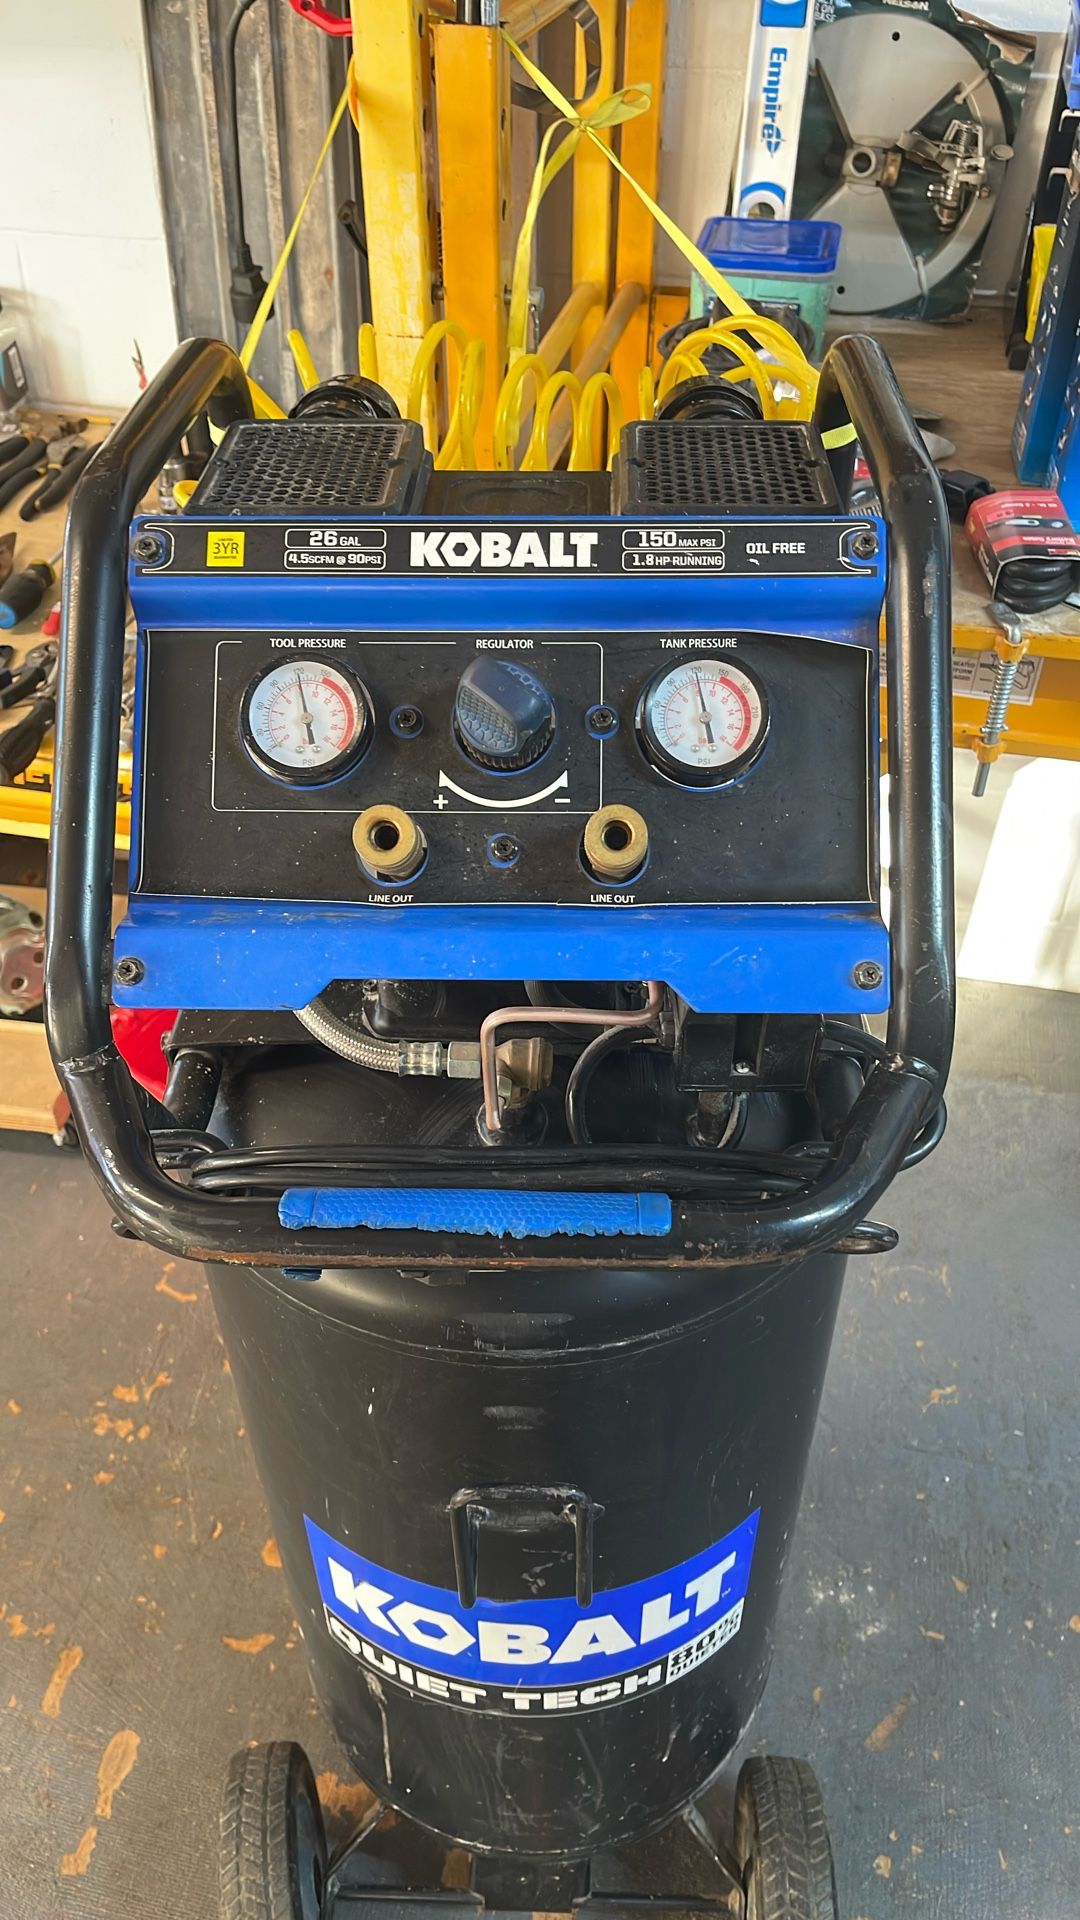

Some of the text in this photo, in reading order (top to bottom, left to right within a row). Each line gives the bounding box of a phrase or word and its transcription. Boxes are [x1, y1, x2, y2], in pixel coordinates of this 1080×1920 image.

[762, 47, 788, 154] Empire
[309, 530, 361, 546] 26 GAL
[638, 531, 716, 547] 150 MAX PSI
[212, 542, 239, 554] 3YR
[410, 531, 598, 568] KOBALT
[746, 542, 806, 554] OIL FREE
[288, 553, 382, 565] 4.5SCFM @ 90PSI
[632, 554, 654, 566] 1.8
[672, 556, 722, 566] RUNNING
[269, 638, 347, 648] TOOL PRESSURE
[475, 639, 534, 649] REGULATOR
[660, 638, 738, 649] TANK PRESSURE
[718, 668, 729, 677] 150
[751, 706, 759, 718] 210
[368, 894, 414, 903] LINE OUT
[590, 894, 636, 903] LINE OUT
[327, 1551, 737, 1665] KOBALT
[329, 1616, 662, 1710] QUIET TECH
